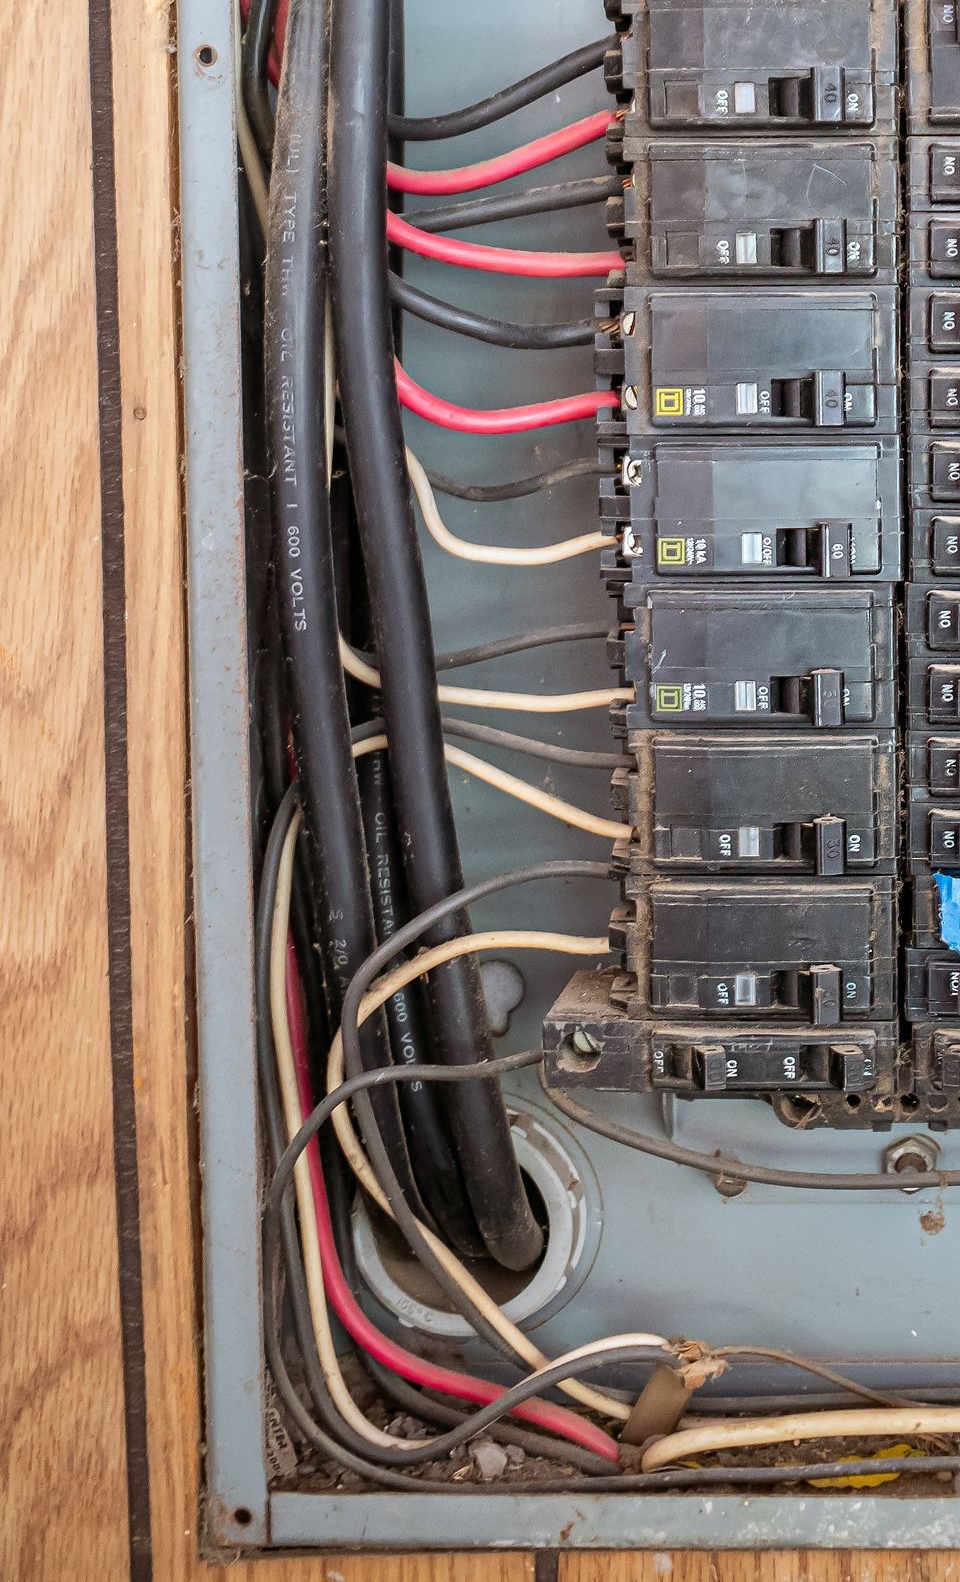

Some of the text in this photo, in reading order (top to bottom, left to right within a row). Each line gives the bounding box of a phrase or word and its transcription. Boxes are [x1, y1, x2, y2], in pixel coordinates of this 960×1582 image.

[943, 4, 954, 24] ON
[715, 89, 729, 115] OFF
[848, 92, 859, 112] ON
[943, 156, 956, 176] ON
[283, 192, 297, 243] TYPE
[945, 238, 958, 257] ON
[943, 311, 955, 331] ON
[759, 390, 770, 415] OFF
[946, 387, 958, 406] ON
[281, 375, 297, 486] RESISTANT
[947, 462, 960, 481] ON
[287, 525, 301, 558] 600
[832, 543, 844, 559] 60
[946, 535, 958, 554] ON
[290, 568, 307, 632] VOLTS
[938, 610, 951, 629] ON
[757, 686, 769, 710] OFF
[945, 758, 957, 777] ON
[375, 812, 387, 843] OIL
[718, 834, 731, 857] OFF
[848, 834, 861, 852] ON
[943, 830, 955, 849] ON
[377, 854, 395, 935] RESISTA
[716, 982, 729, 1005] OFF
[846, 982, 857, 999] ON
[393, 992, 408, 1022] 600
[726, 1059, 738, 1078] ON
[783, 1056, 796, 1079] OFF
